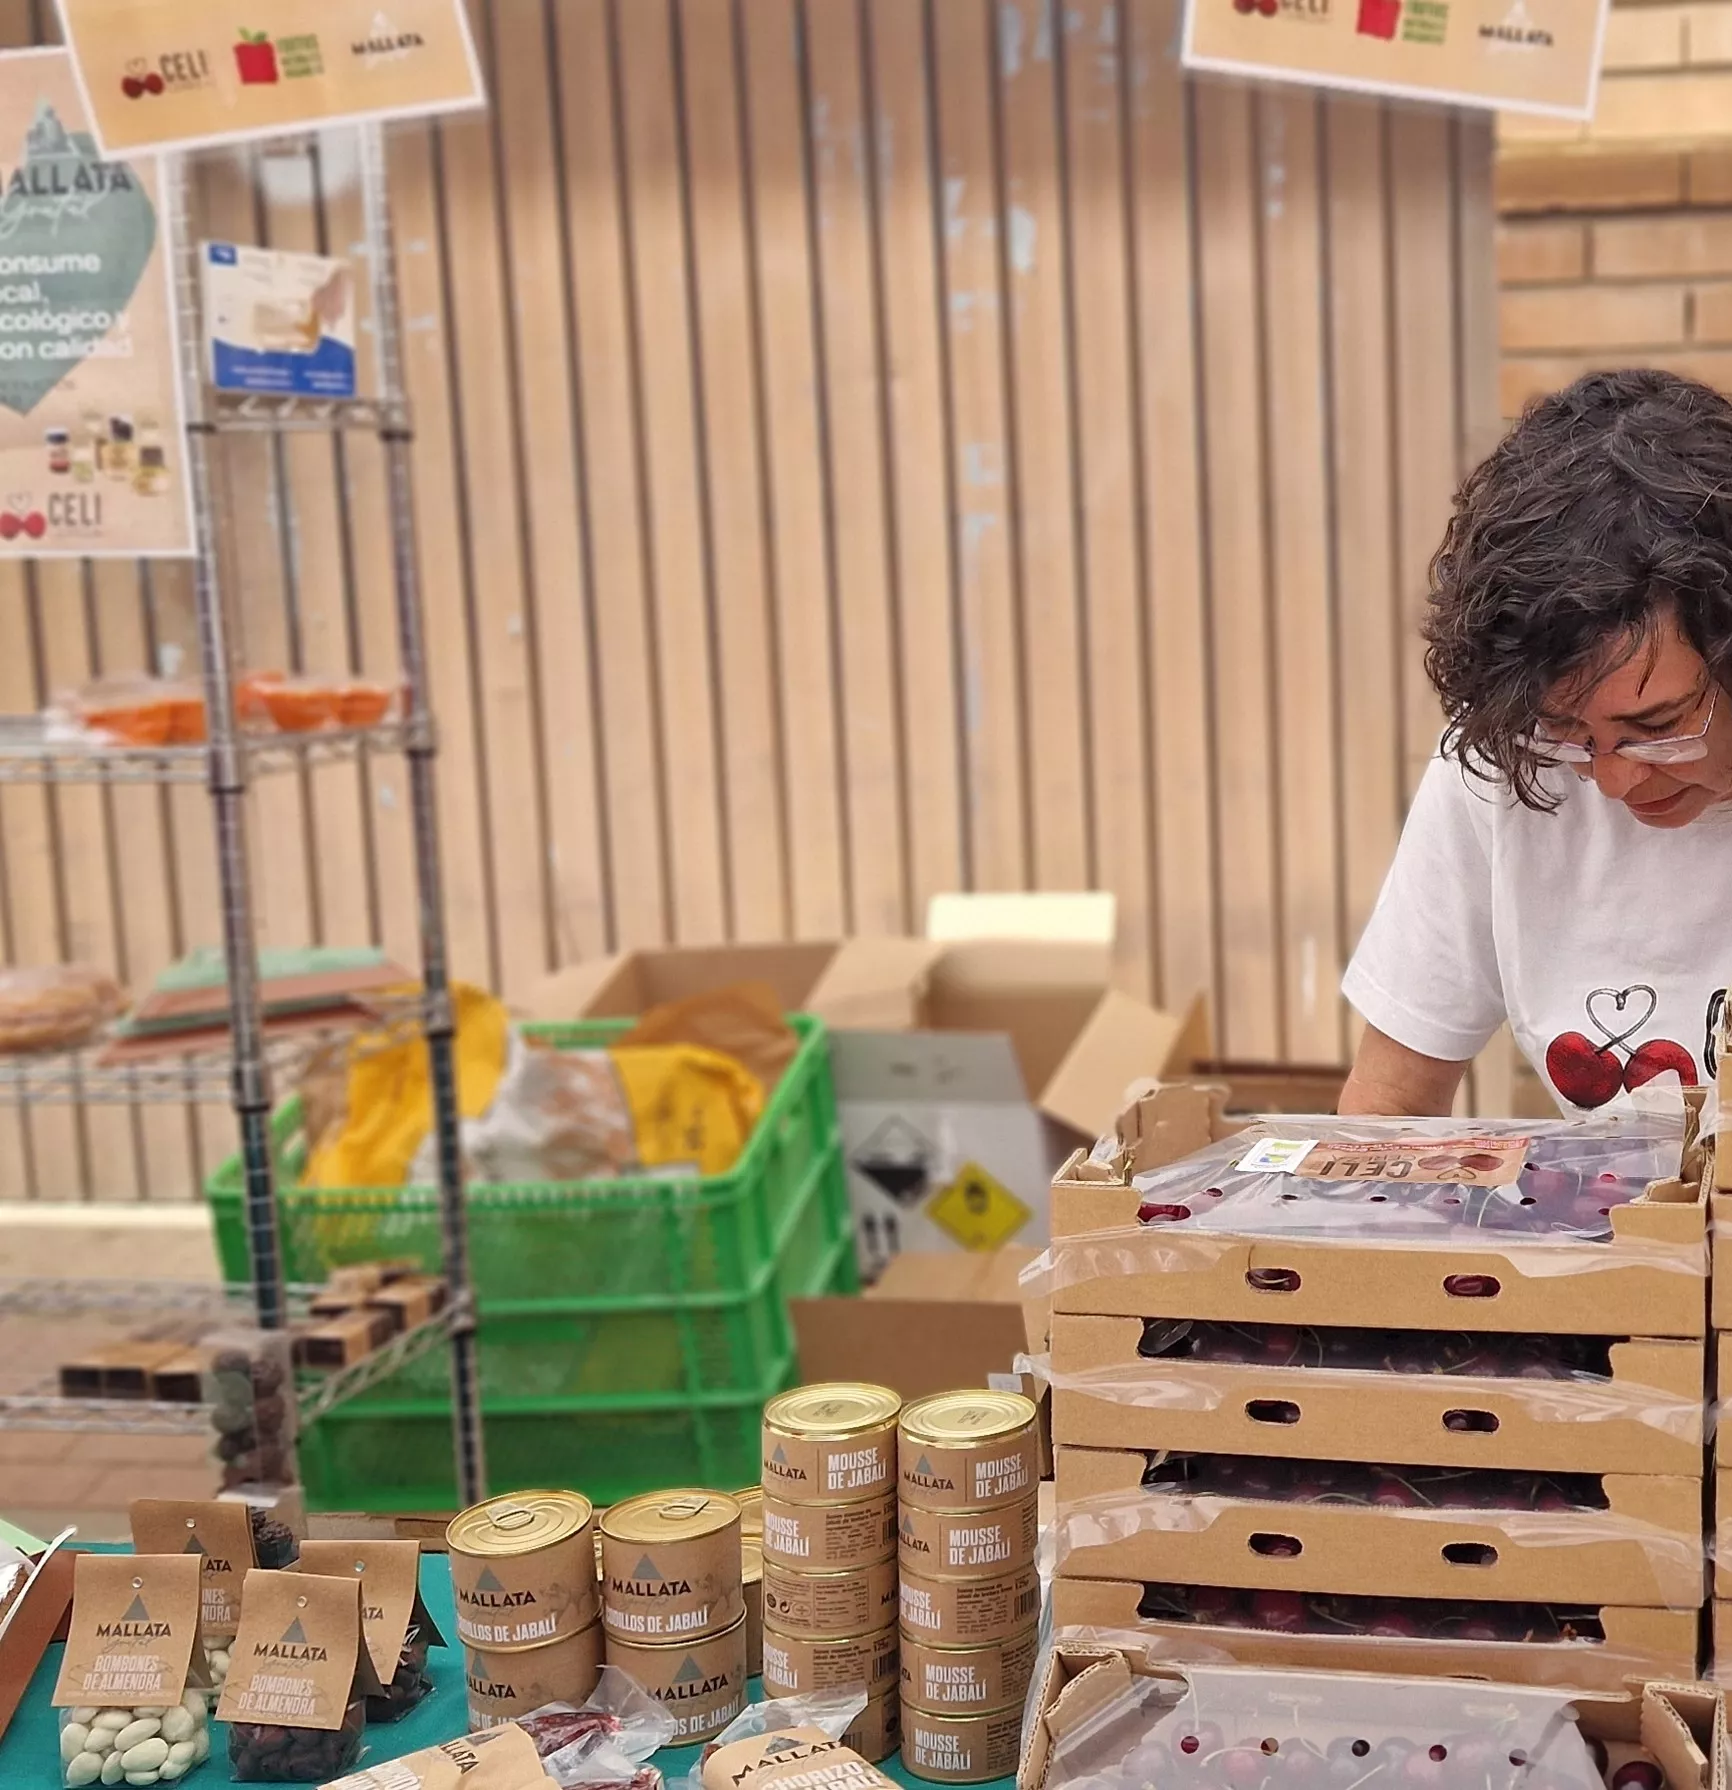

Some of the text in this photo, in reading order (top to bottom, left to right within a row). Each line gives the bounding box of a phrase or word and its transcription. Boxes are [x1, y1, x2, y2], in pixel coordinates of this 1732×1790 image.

[158, 49, 209, 83] CELI
[0, 162, 132, 195] ALLATA
[0, 253, 100, 275] onsume
[0, 280, 49, 304] cal,
[0, 306, 111, 335] cológico
[0, 341, 33, 360] on
[48, 492, 102, 526] CELI
[1321, 1159, 1415, 1178] CELI
[828, 1447, 878, 1472] MOUSSE
[976, 1453, 1022, 1480] MOUSSE
[828, 1459, 887, 1490] DE JABALÍ
[903, 1470, 955, 1490] MALLATA
[976, 1466, 1029, 1498] DE JABALÍ
[765, 1510, 799, 1538] MOUSSE
[774, 1536, 810, 1557] JABALÍ
[950, 1525, 1001, 1547] MOUSSE
[950, 1537, 1010, 1565] DE JABALÍ
[459, 1589, 537, 1608] MALLATA
[612, 1580, 692, 1597] MALLATA
[494, 1625, 510, 1642] DE
[512, 1612, 557, 1641] JABALÍ
[647, 1615, 663, 1633] DE
[665, 1603, 708, 1632] JABALÍ
[908, 1605, 941, 1630] JABALÍ
[96, 1623, 172, 1637] MALLATA
[94, 1655, 160, 1672] BOMBONES
[253, 1642, 328, 1662] MALLATA
[83, 1673, 162, 1691] DE ALMENDRA
[250, 1674, 314, 1694] BOMBONES
[925, 1664, 976, 1684] MOUSSE
[467, 1675, 516, 1699] ALLATA
[926, 1679, 986, 1701] DE JABALÍ
[238, 1692, 316, 1715] DE ALMENDRA
[690, 1715, 705, 1733] DE
[915, 1728, 960, 1753] MOUSSE
[731, 1741, 842, 1787] MALLAT
[915, 1748, 971, 1770] DE JABALÍ
